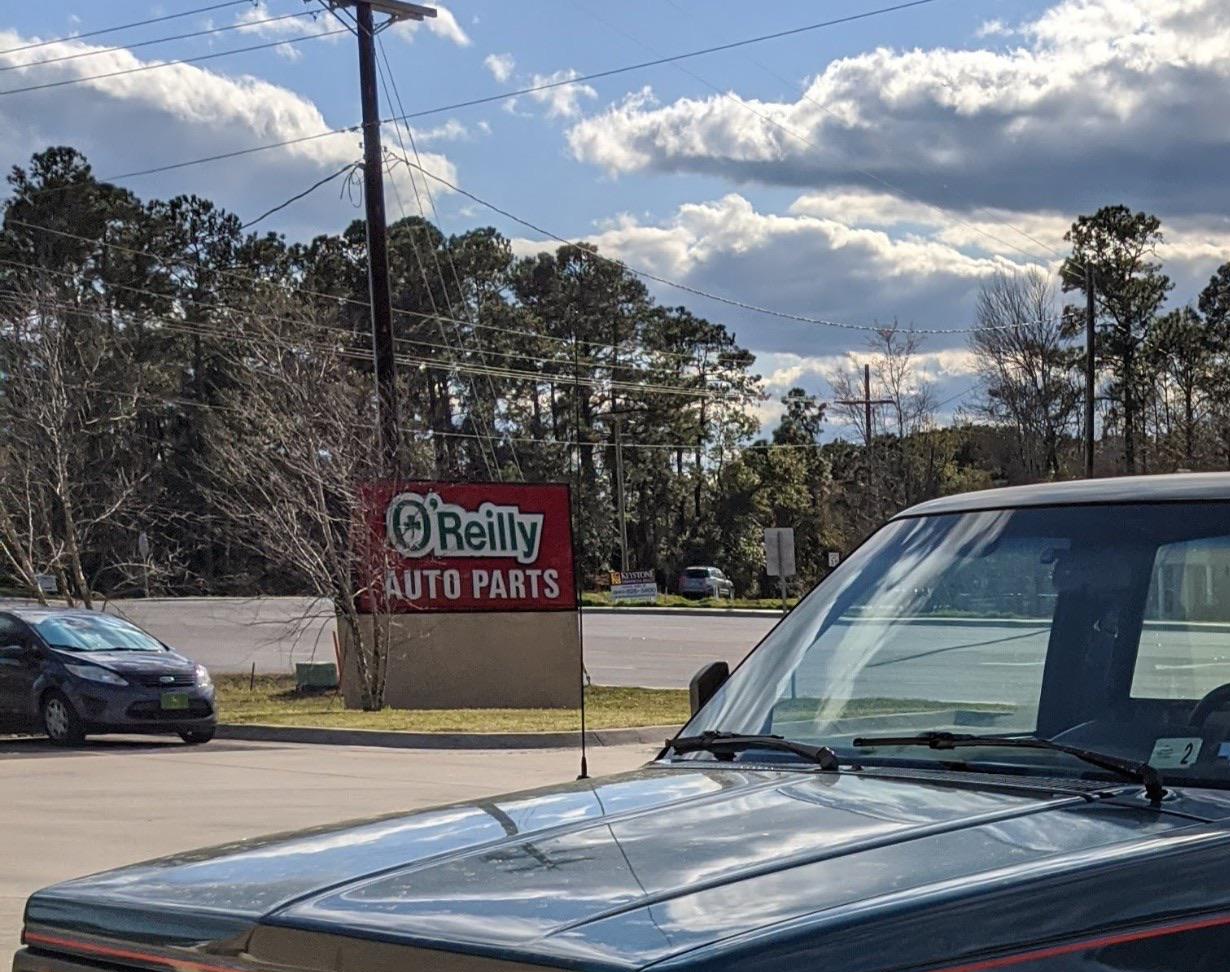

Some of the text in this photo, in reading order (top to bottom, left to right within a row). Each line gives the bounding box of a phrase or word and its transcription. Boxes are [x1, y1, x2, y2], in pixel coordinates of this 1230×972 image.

[391, 497, 539, 559] O'Reilly
[386, 568, 560, 601] AUTO PARTS
[1180, 742, 1194, 765] 2
